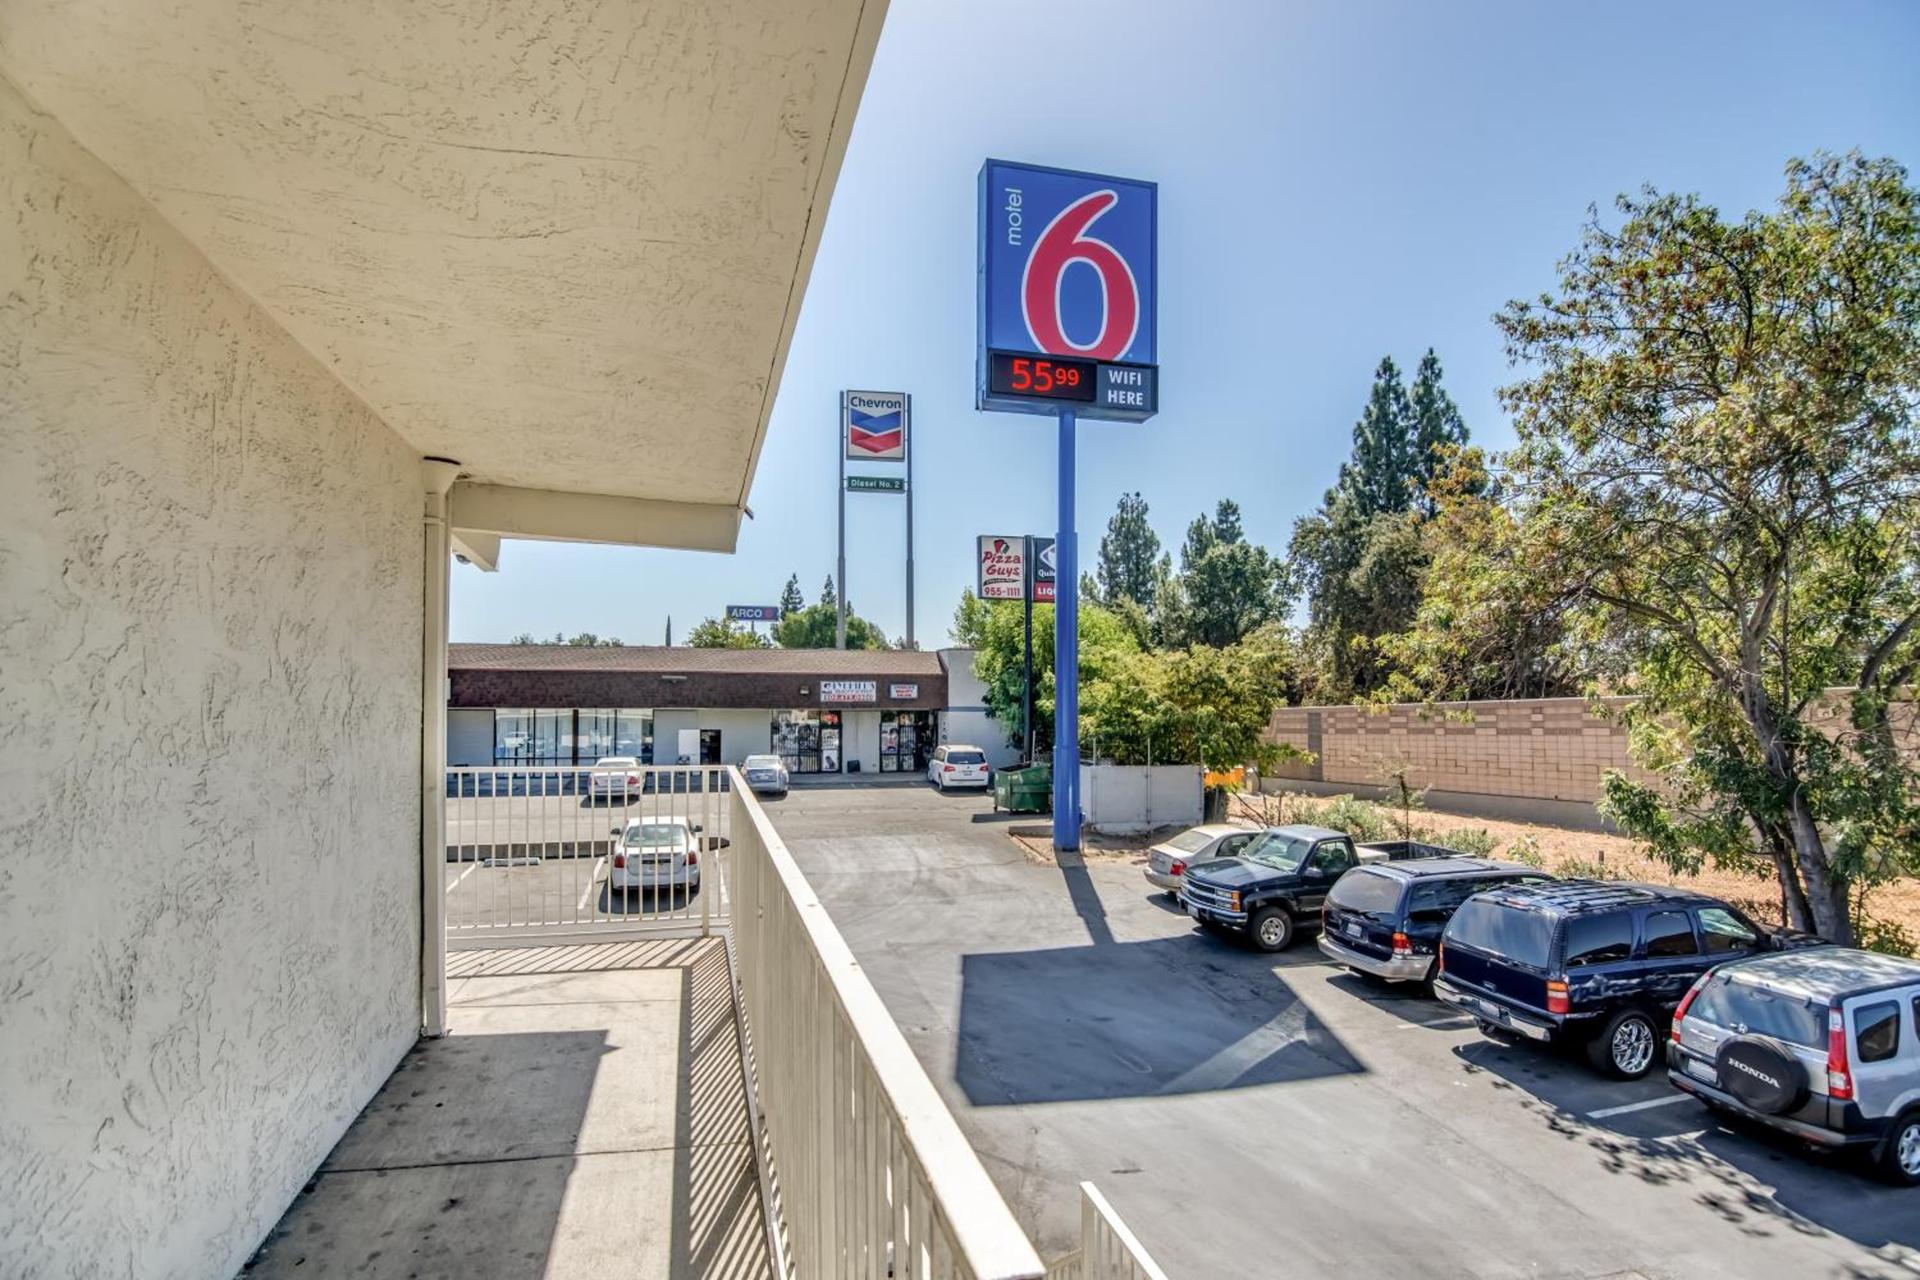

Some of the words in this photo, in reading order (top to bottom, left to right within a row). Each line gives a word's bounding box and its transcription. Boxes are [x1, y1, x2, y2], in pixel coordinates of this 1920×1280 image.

[1005, 188, 1022, 246] motel
[1021, 189, 1140, 361] 6
[1109, 370, 1142, 386] WIFI
[850, 396, 902, 409] Chevron
[1107, 390, 1144, 406] HERE
[850, 479, 877, 488] Diesel
[894, 480, 900, 489] 2
[982, 551, 1021, 564] Pizza
[986, 564, 1020, 577] Guys
[984, 586, 1020, 596] 955-1111
[731, 608, 763, 618] ARCO
[1728, 1057, 1780, 1088] HONDA
